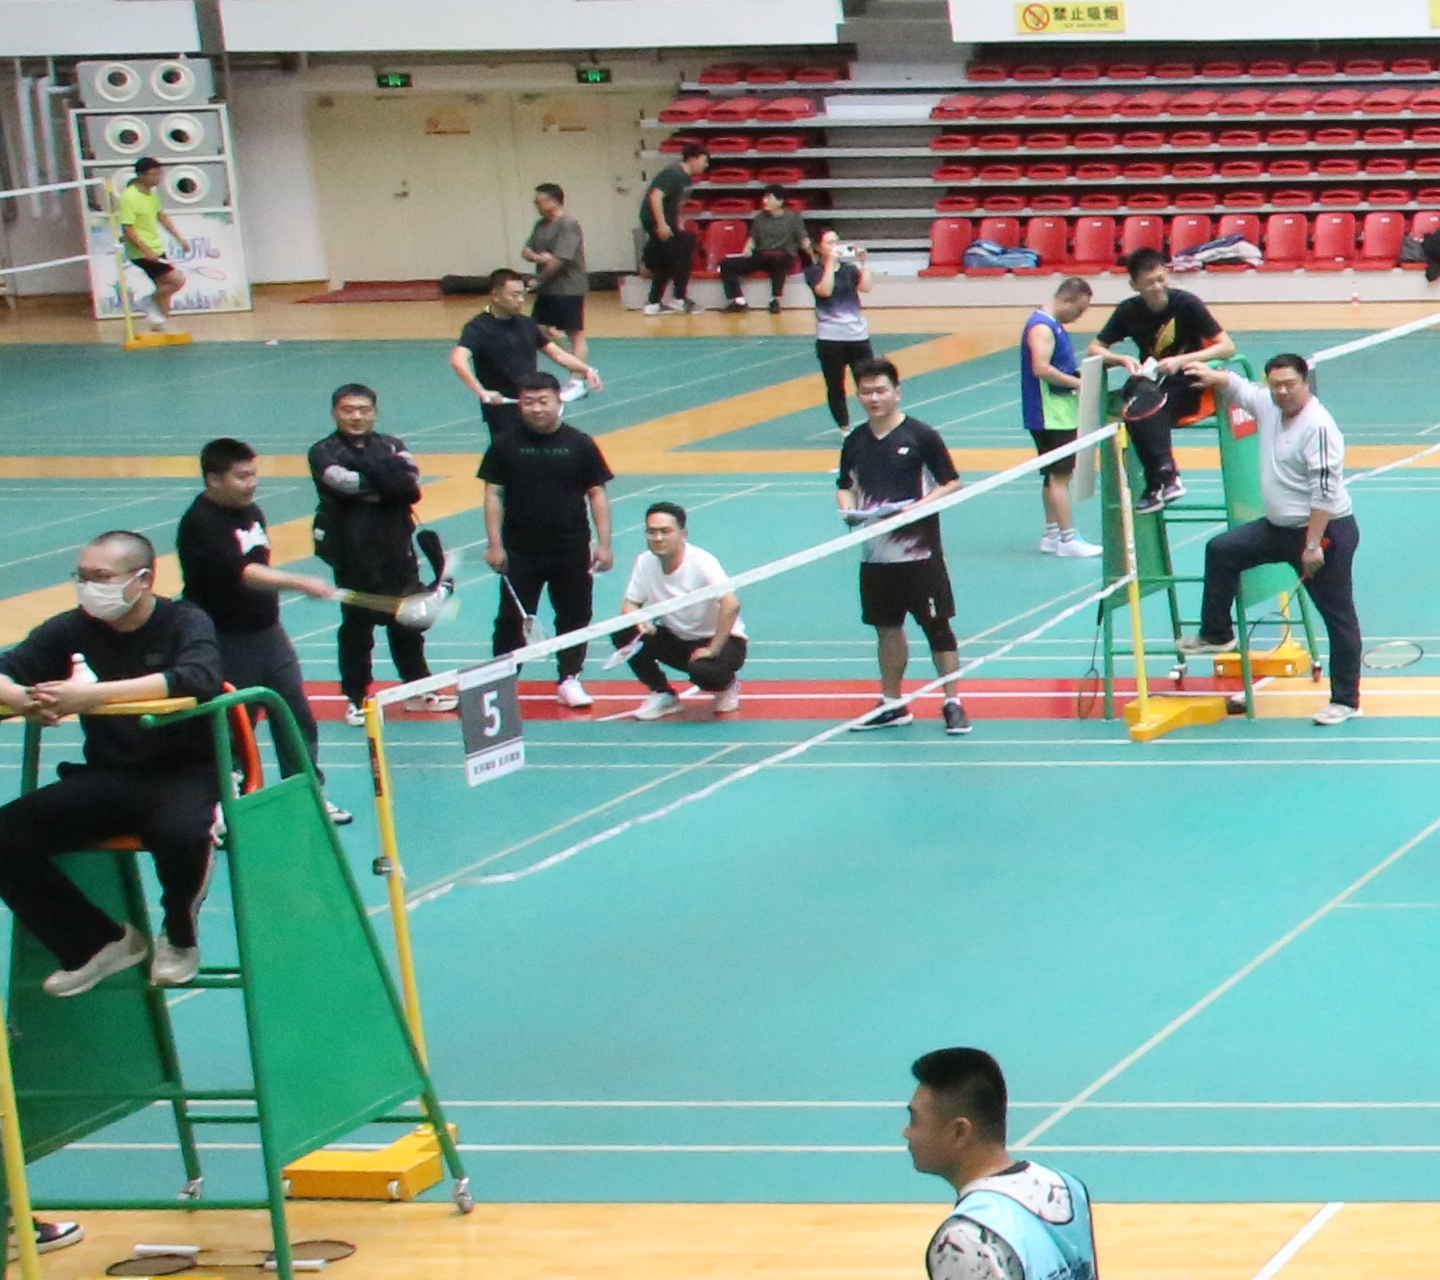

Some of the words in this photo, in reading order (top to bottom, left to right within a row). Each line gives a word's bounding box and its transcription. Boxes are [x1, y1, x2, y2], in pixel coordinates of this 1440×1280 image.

[1053, 5, 1119, 21] 禁止吸烟
[482, 690, 501, 737] 5
